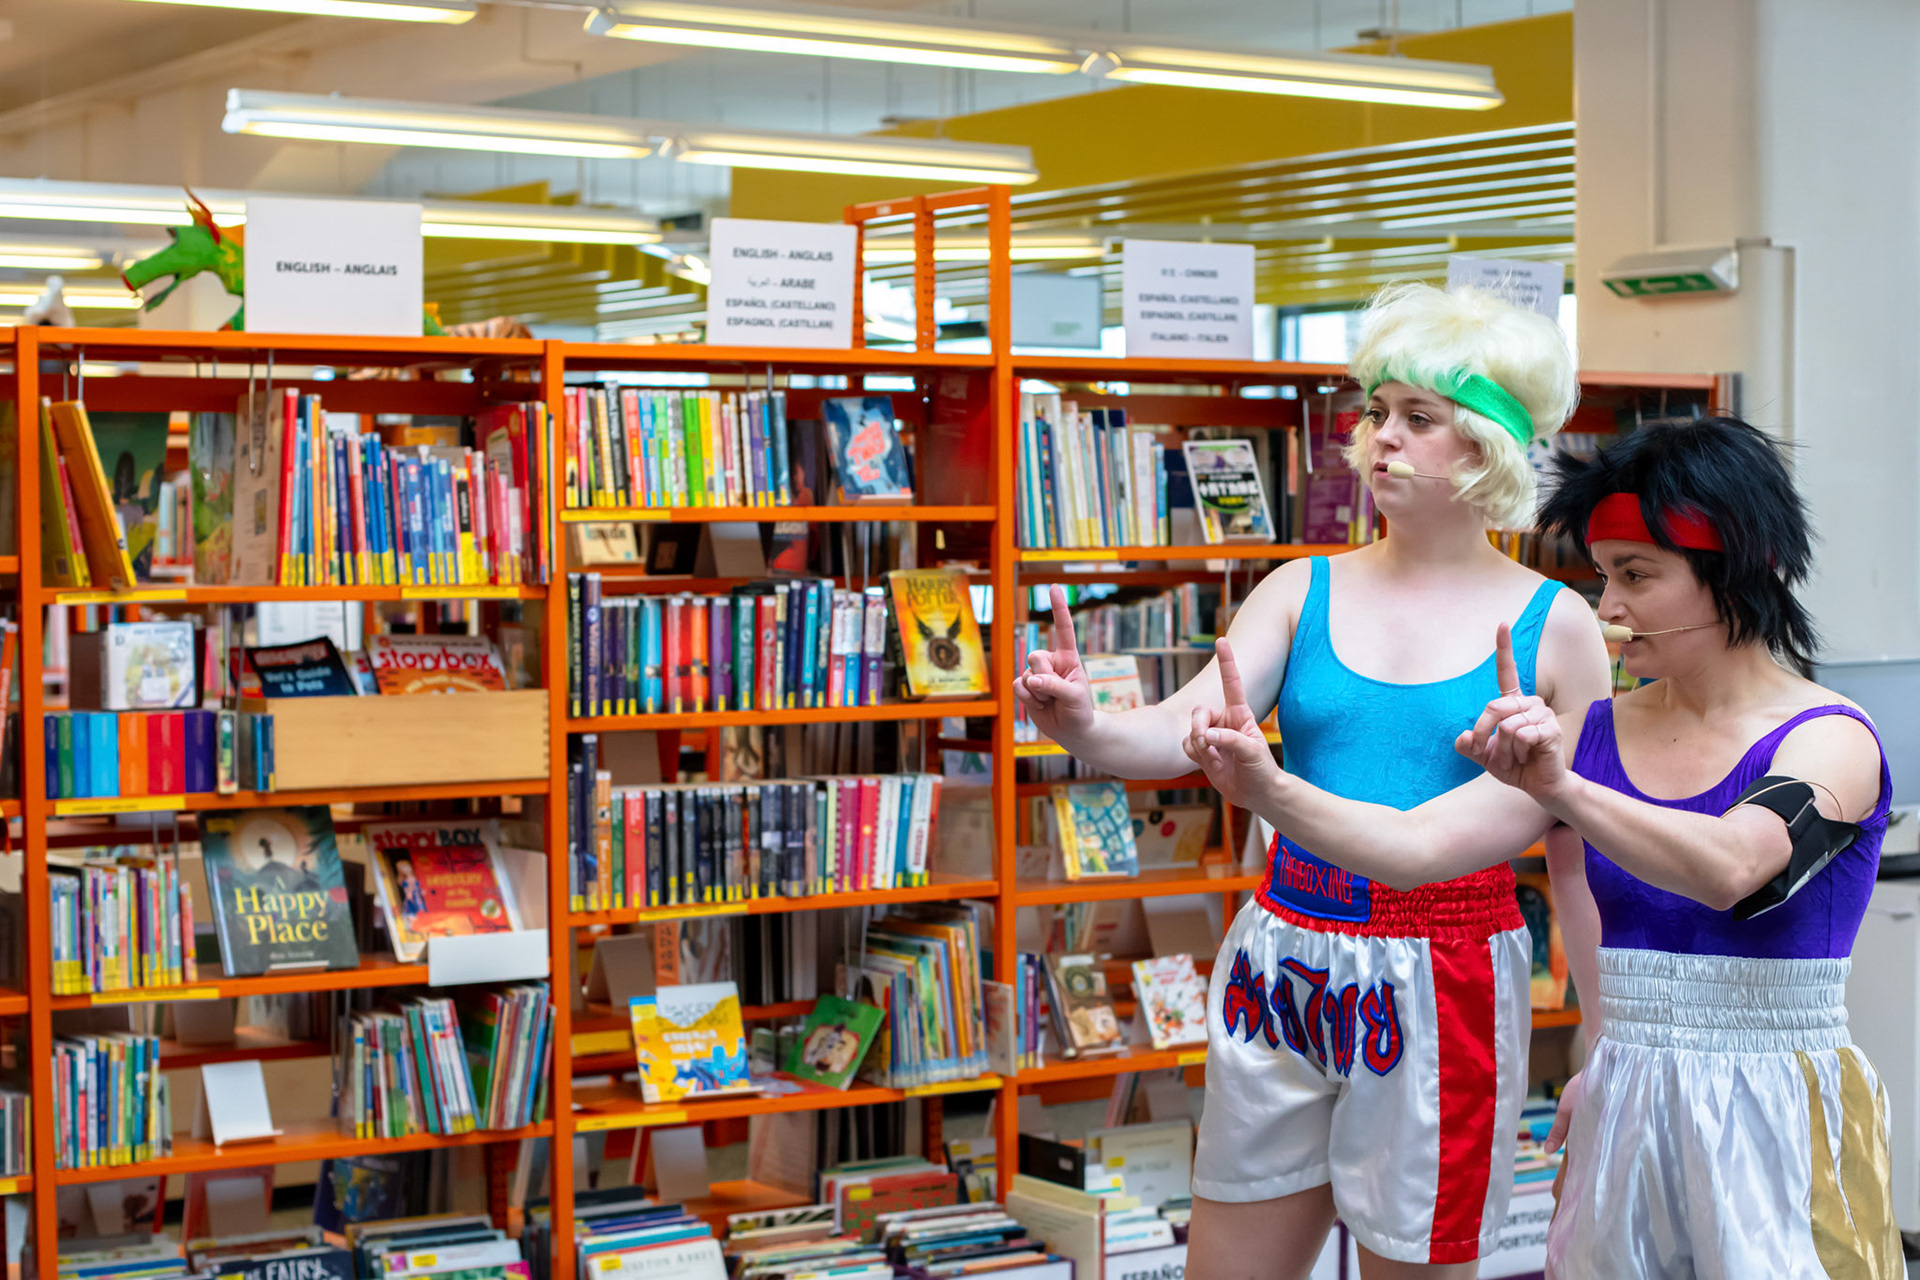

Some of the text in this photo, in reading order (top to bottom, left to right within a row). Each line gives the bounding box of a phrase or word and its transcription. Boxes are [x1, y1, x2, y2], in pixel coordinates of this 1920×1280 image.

[733, 247, 778, 258] ENGLISH
[788, 250, 833, 262] ANGLAIS
[276, 261, 331, 273] ENGLISH
[344, 264, 398, 276] ANGLAIS
[780, 278, 815, 290] ARABE
[726, 297, 836, 312] ESPAÑOL (CASTELLANO)
[726, 317, 833, 331] ESPAGNOL (CASTILLAN)
[234, 885, 329, 920] Happy
[247, 914, 329, 945] Place
[266, 1257, 330, 1280] FAIRY
[1122, 1262, 1185, 1280] ESPAÑO
